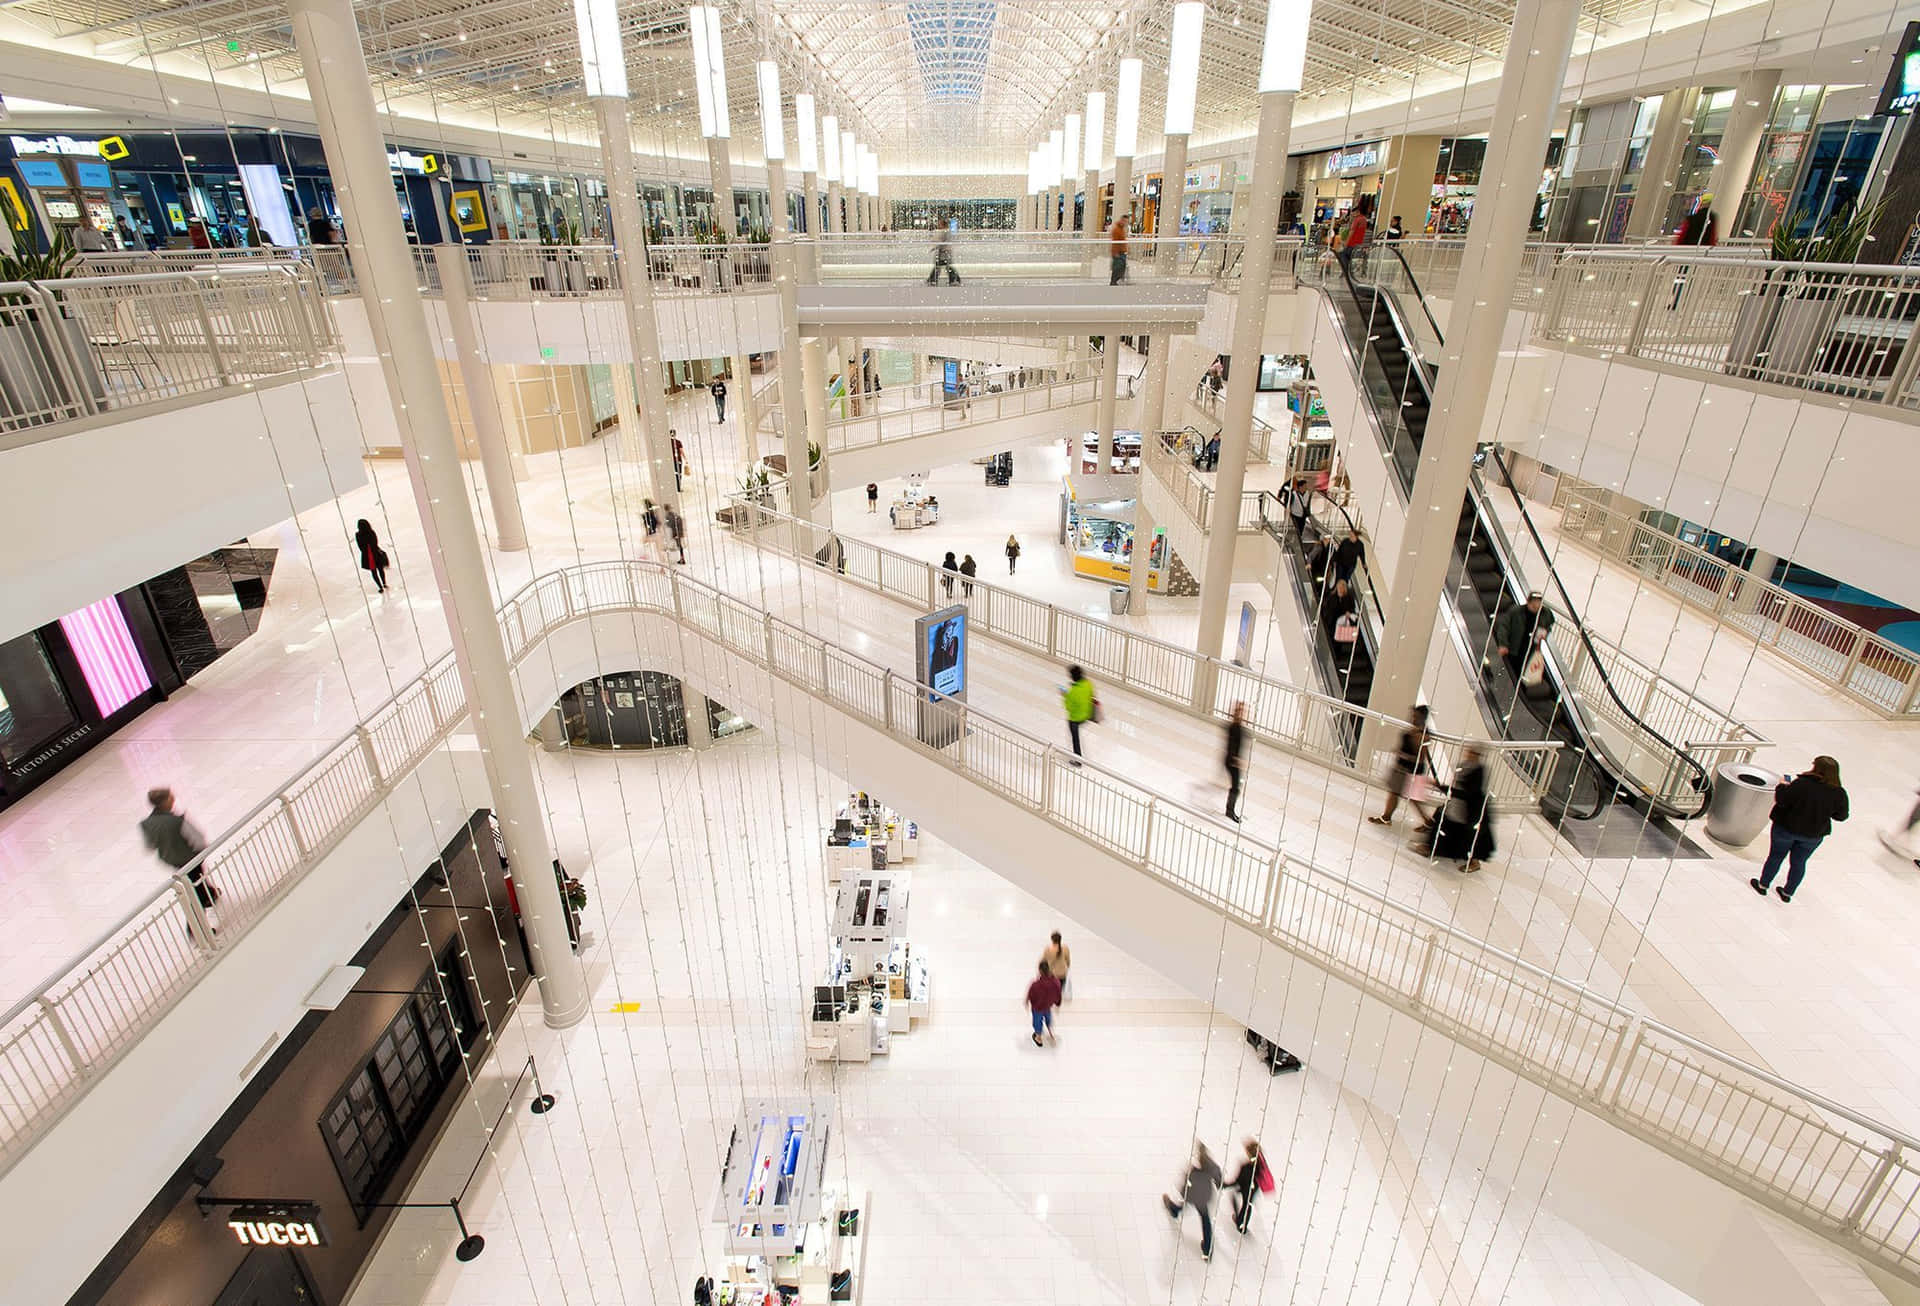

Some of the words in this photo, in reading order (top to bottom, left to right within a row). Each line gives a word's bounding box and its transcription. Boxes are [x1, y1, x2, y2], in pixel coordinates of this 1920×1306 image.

[1889, 92, 1920, 110] FRO
[12, 743, 64, 777] VICTORIAS
[61, 724, 92, 747] SECRET
[227, 1220, 320, 1246] TUCCI
